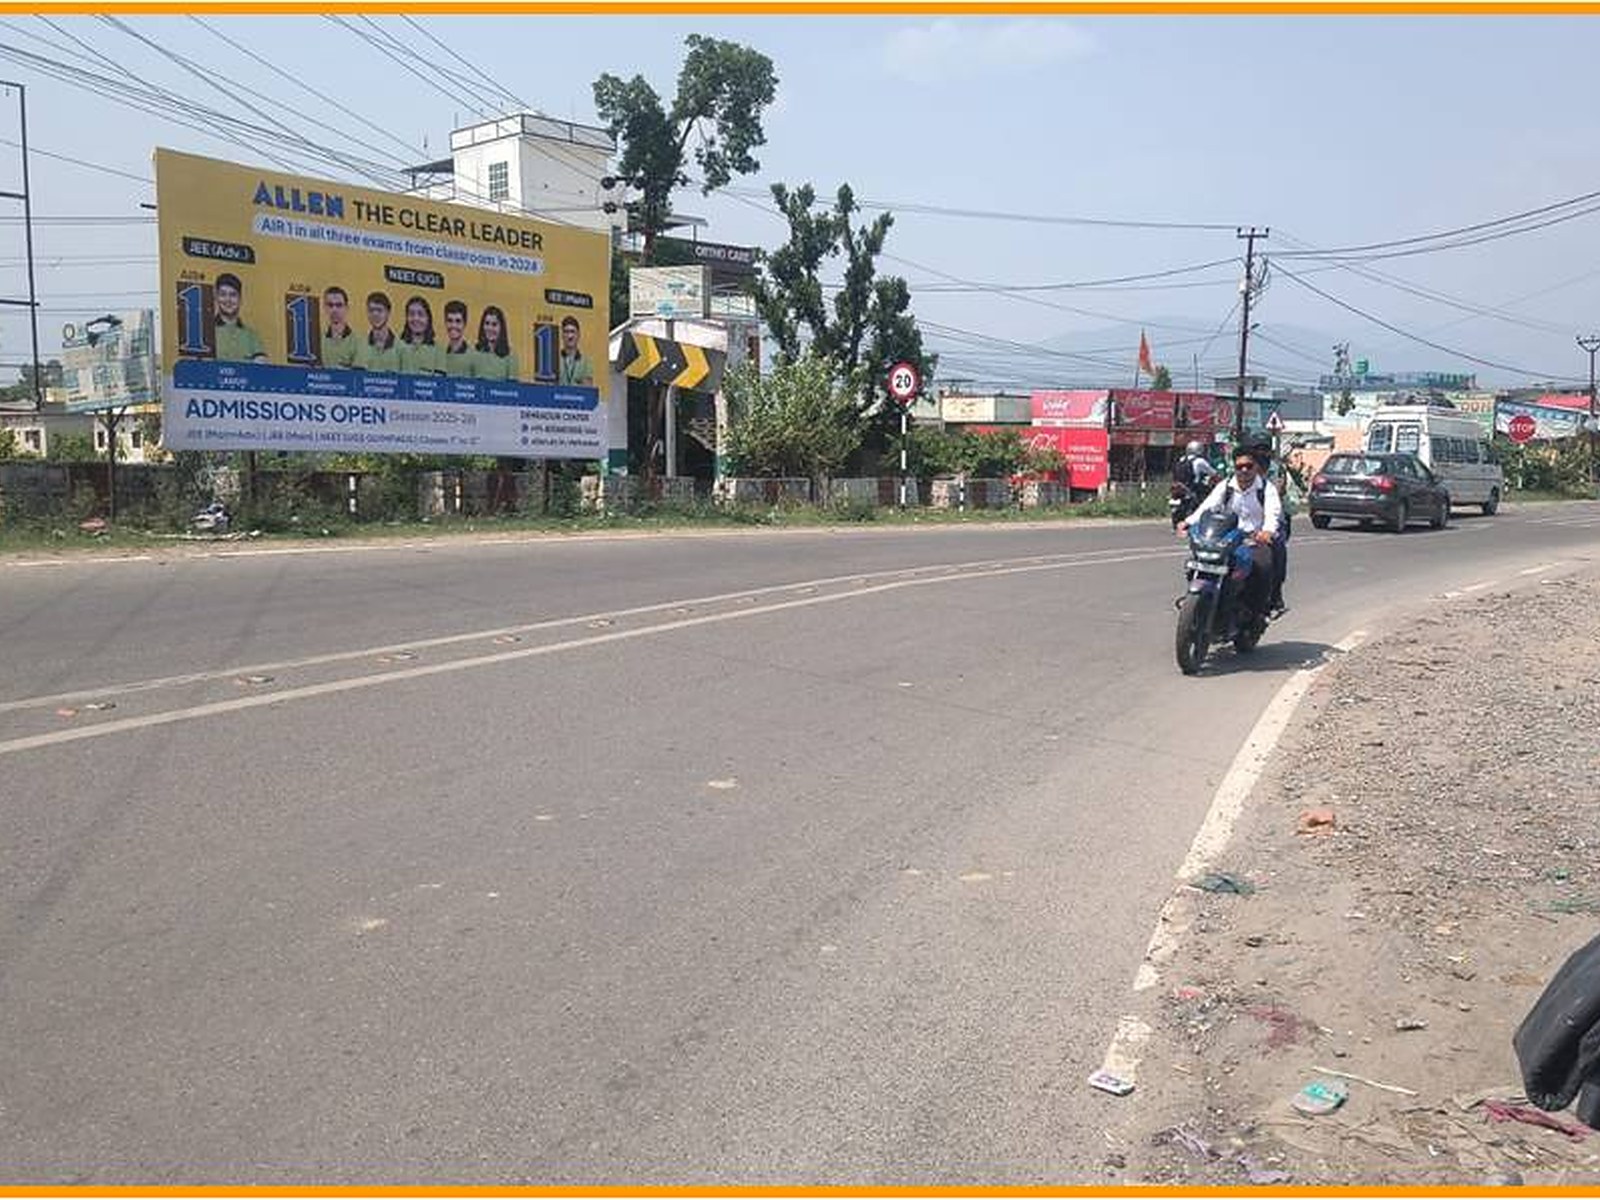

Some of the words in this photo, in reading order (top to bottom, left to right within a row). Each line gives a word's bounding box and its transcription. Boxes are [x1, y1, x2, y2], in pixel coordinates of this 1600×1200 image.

[253, 180, 344, 219] ALLEN
[352, 200, 394, 225] THE
[399, 209, 466, 237] CLEAR
[470, 224, 543, 251] LEADER
[261, 218, 286, 234] AIR
[294, 225, 308, 237] in
[309, 227, 326, 241] all
[326, 230, 361, 246] three
[362, 234, 403, 251] exams
[404, 239, 435, 255] from
[435, 245, 496, 265] classroom
[497, 254, 508, 268] in
[509, 256, 539, 272] 2024
[178, 284, 212, 353] 1
[286, 297, 317, 361] 1
[535, 326, 554, 379] 1
[895, 374, 911, 389] 20
[185, 399, 327, 423] ADMISSIONS
[331, 404, 386, 424] OPEN
[1509, 422, 1535, 434] STOP
